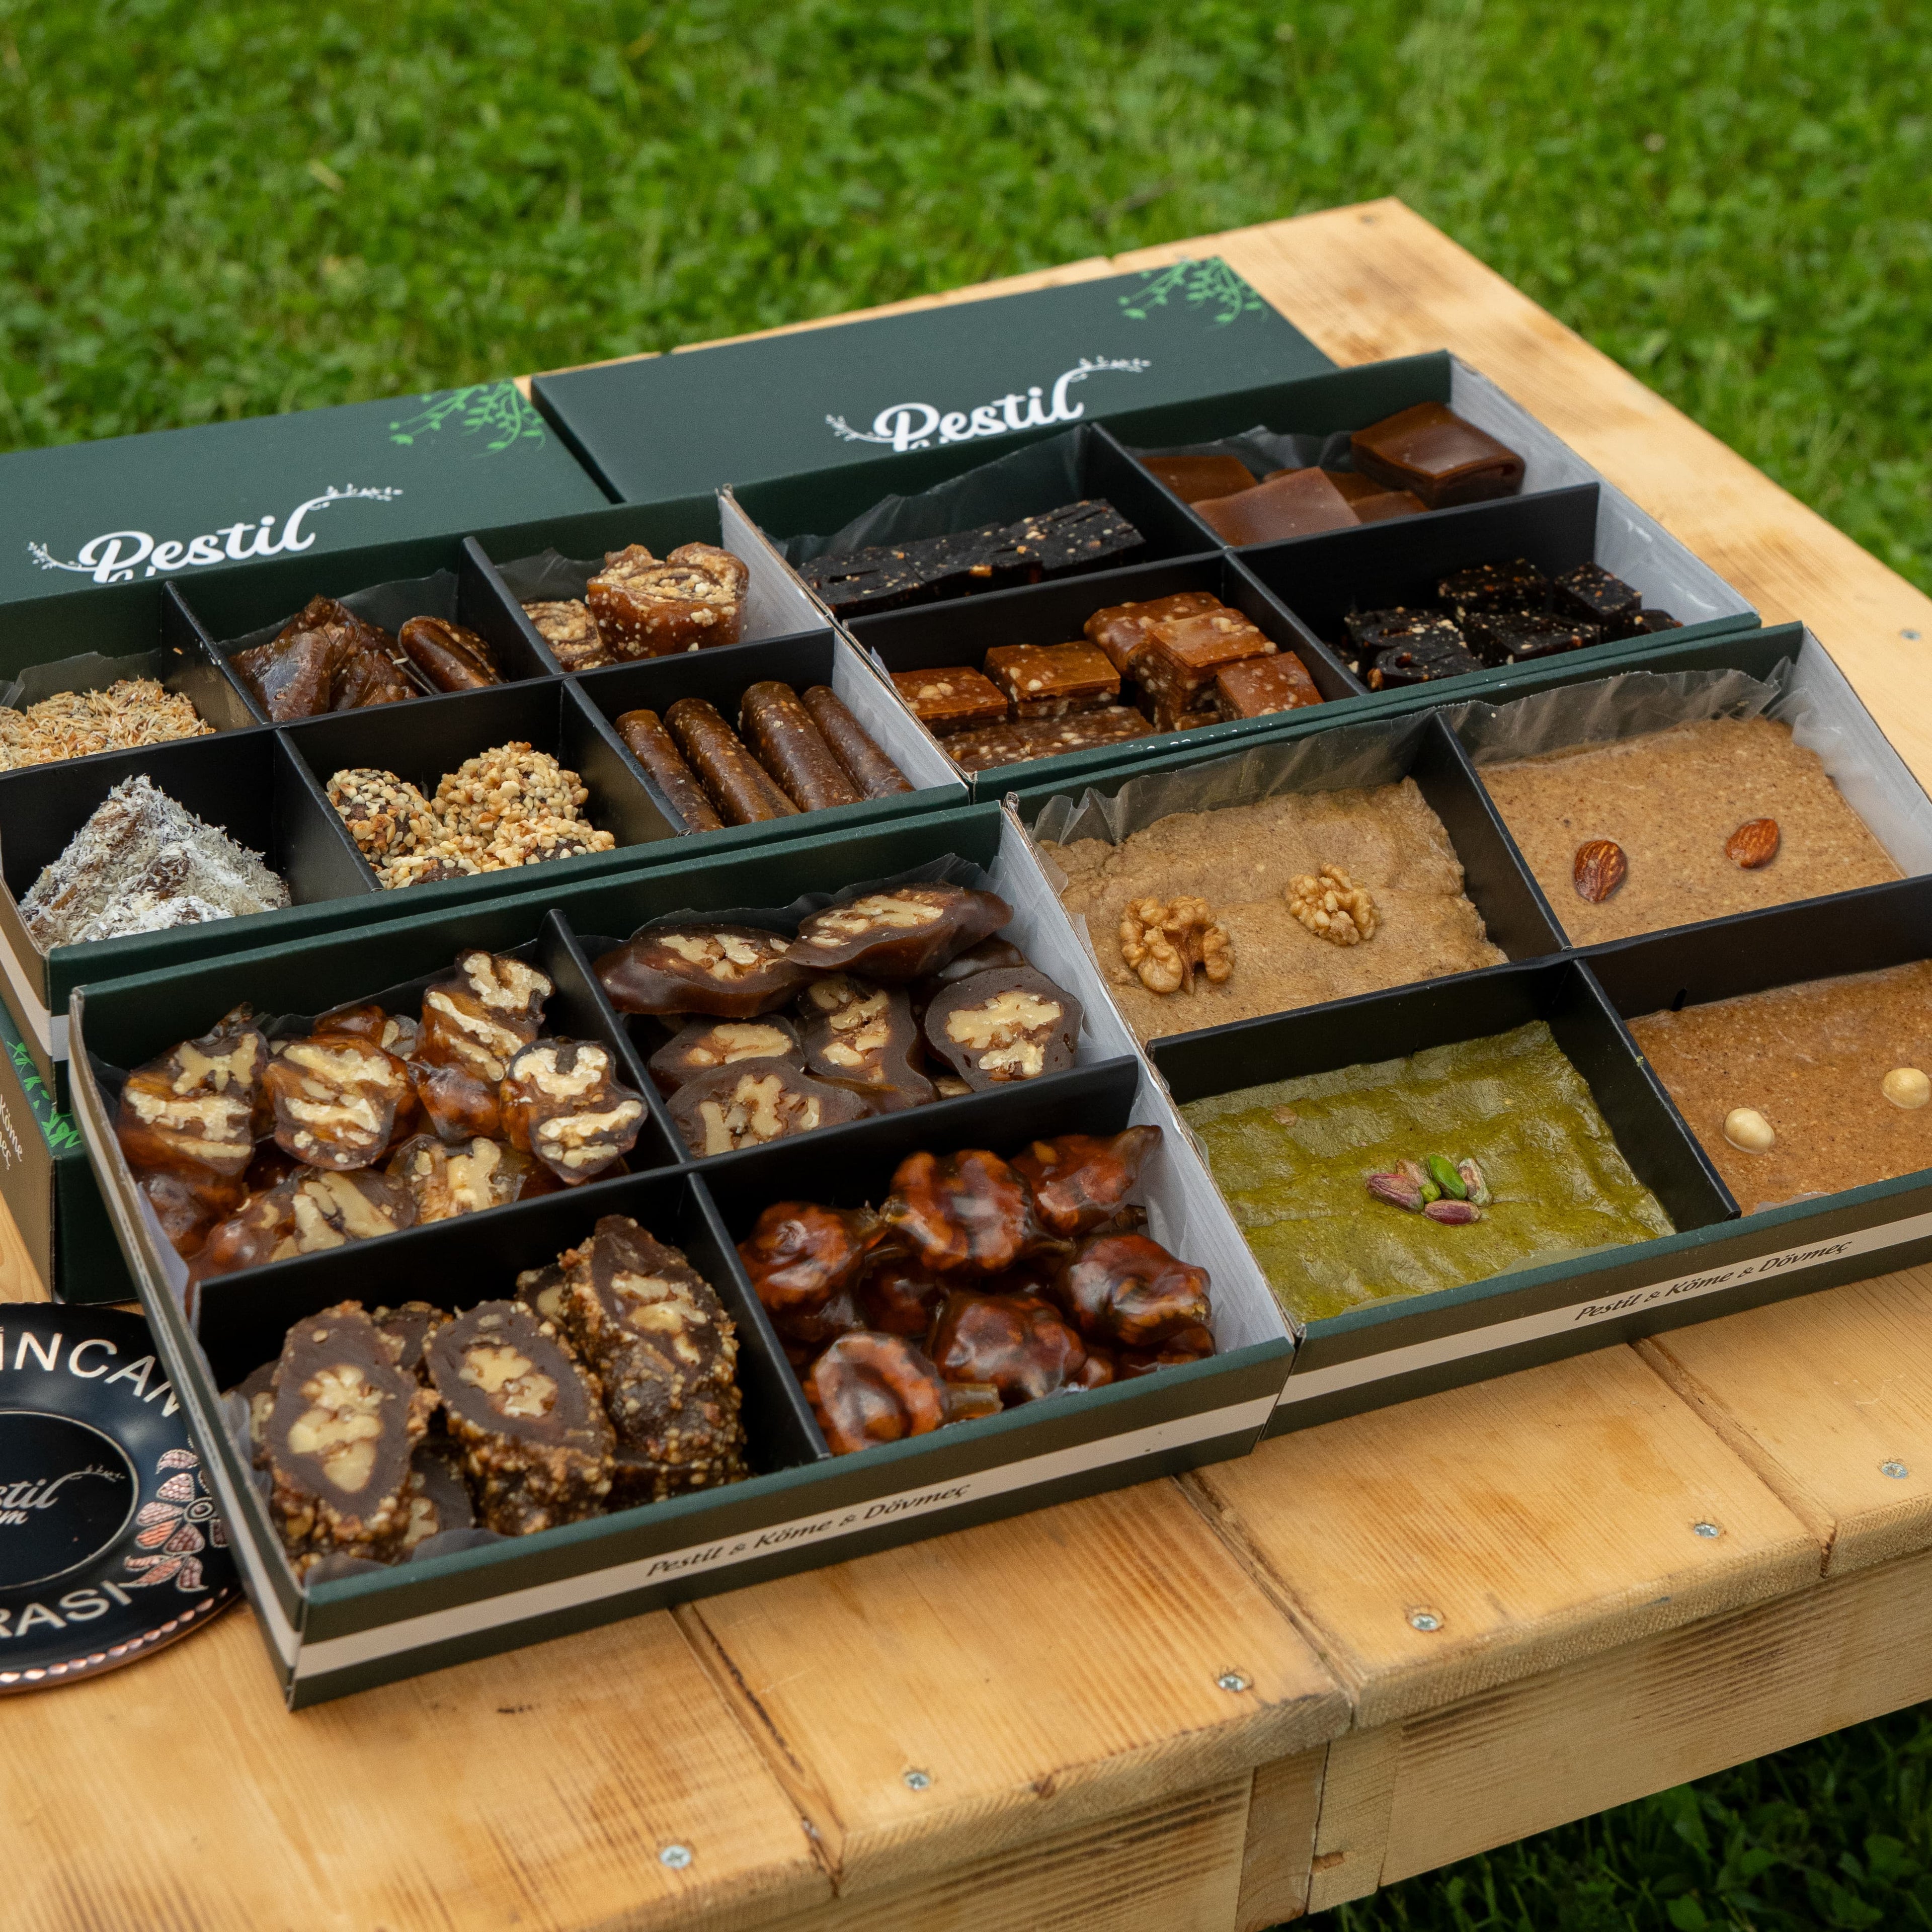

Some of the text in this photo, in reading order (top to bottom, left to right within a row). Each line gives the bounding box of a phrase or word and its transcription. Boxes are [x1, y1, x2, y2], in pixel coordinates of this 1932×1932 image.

[873, 368, 1089, 452] Pestil
[75, 496, 331, 584] Pestil
[1575, 1240, 1853, 1320] Pestil & Köme & Dövmeç
[647, 1483, 971, 1577] Pestil & Köme & Dövmeç
